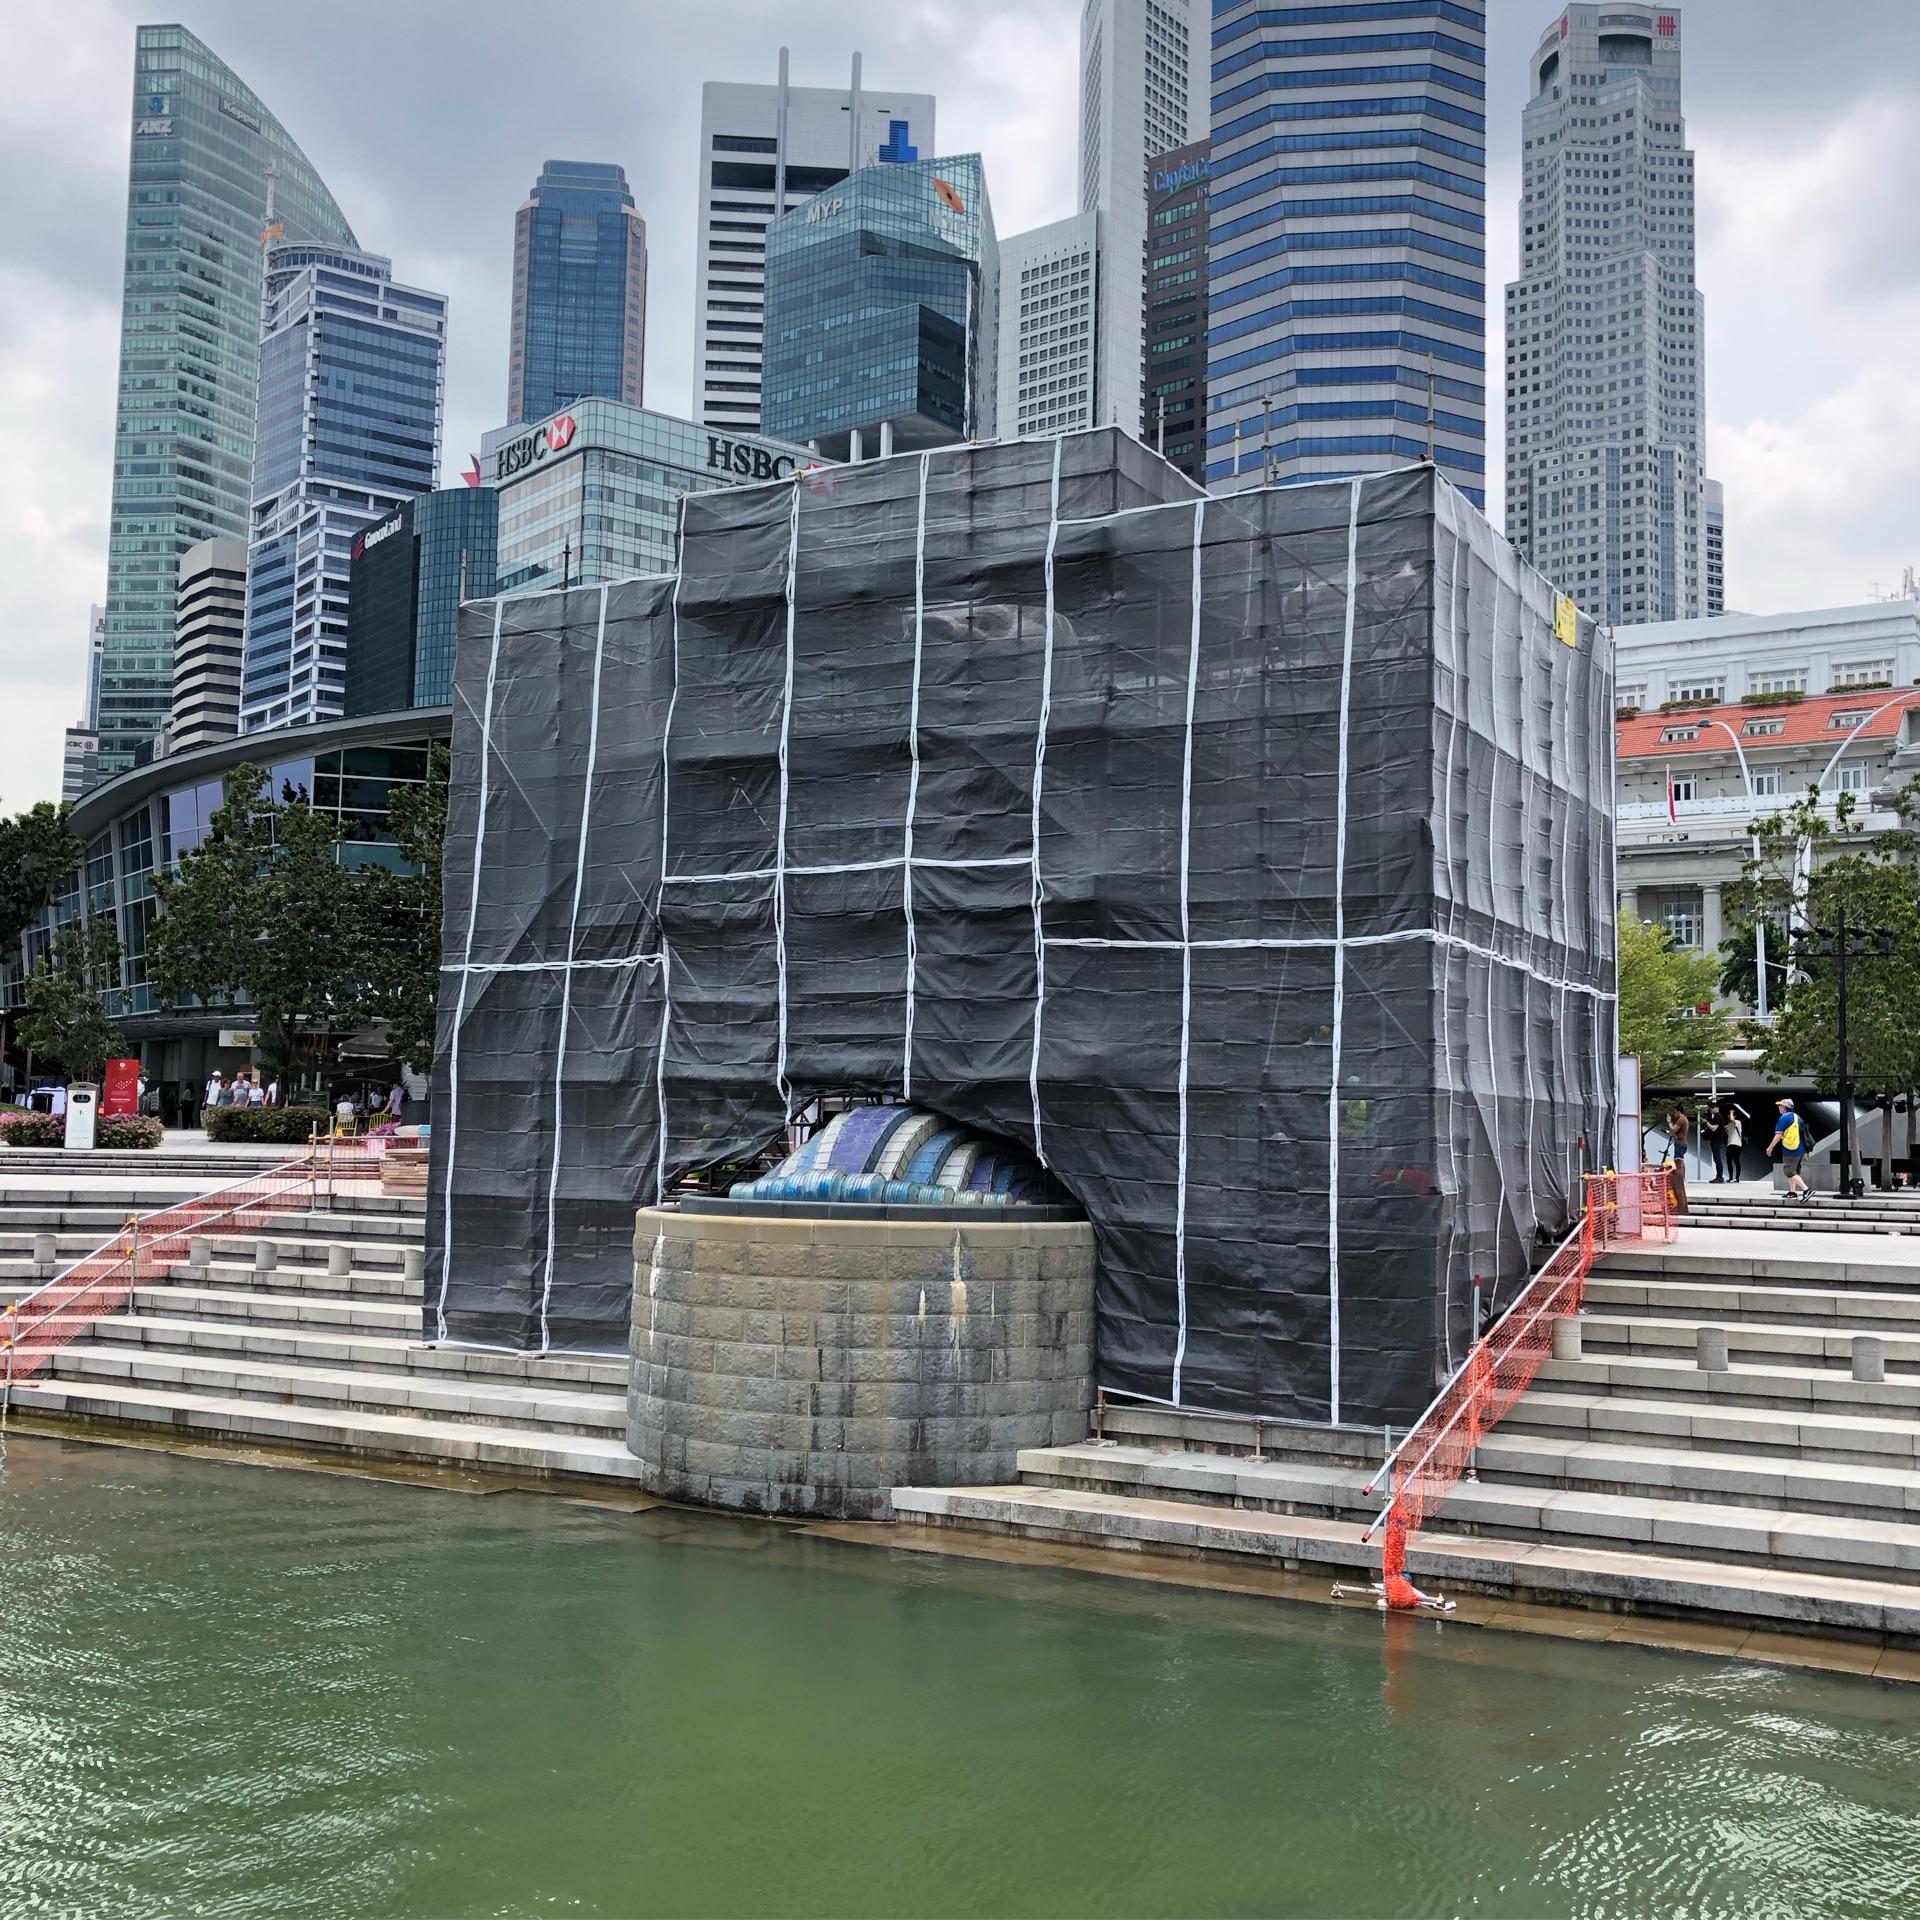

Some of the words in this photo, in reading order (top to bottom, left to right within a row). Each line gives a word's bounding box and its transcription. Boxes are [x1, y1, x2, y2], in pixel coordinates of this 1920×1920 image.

[1651, 39, 1680, 51] UOB
[136, 119, 173, 135] ANZ
[223, 99, 260, 127] Keppel
[806, 197, 845, 226] MYP
[496, 427, 547, 480] HSBC
[706, 436, 795, 481] HSBC
[364, 513, 402, 549] GuocoLand
[66, 740, 83, 749] ICBC
